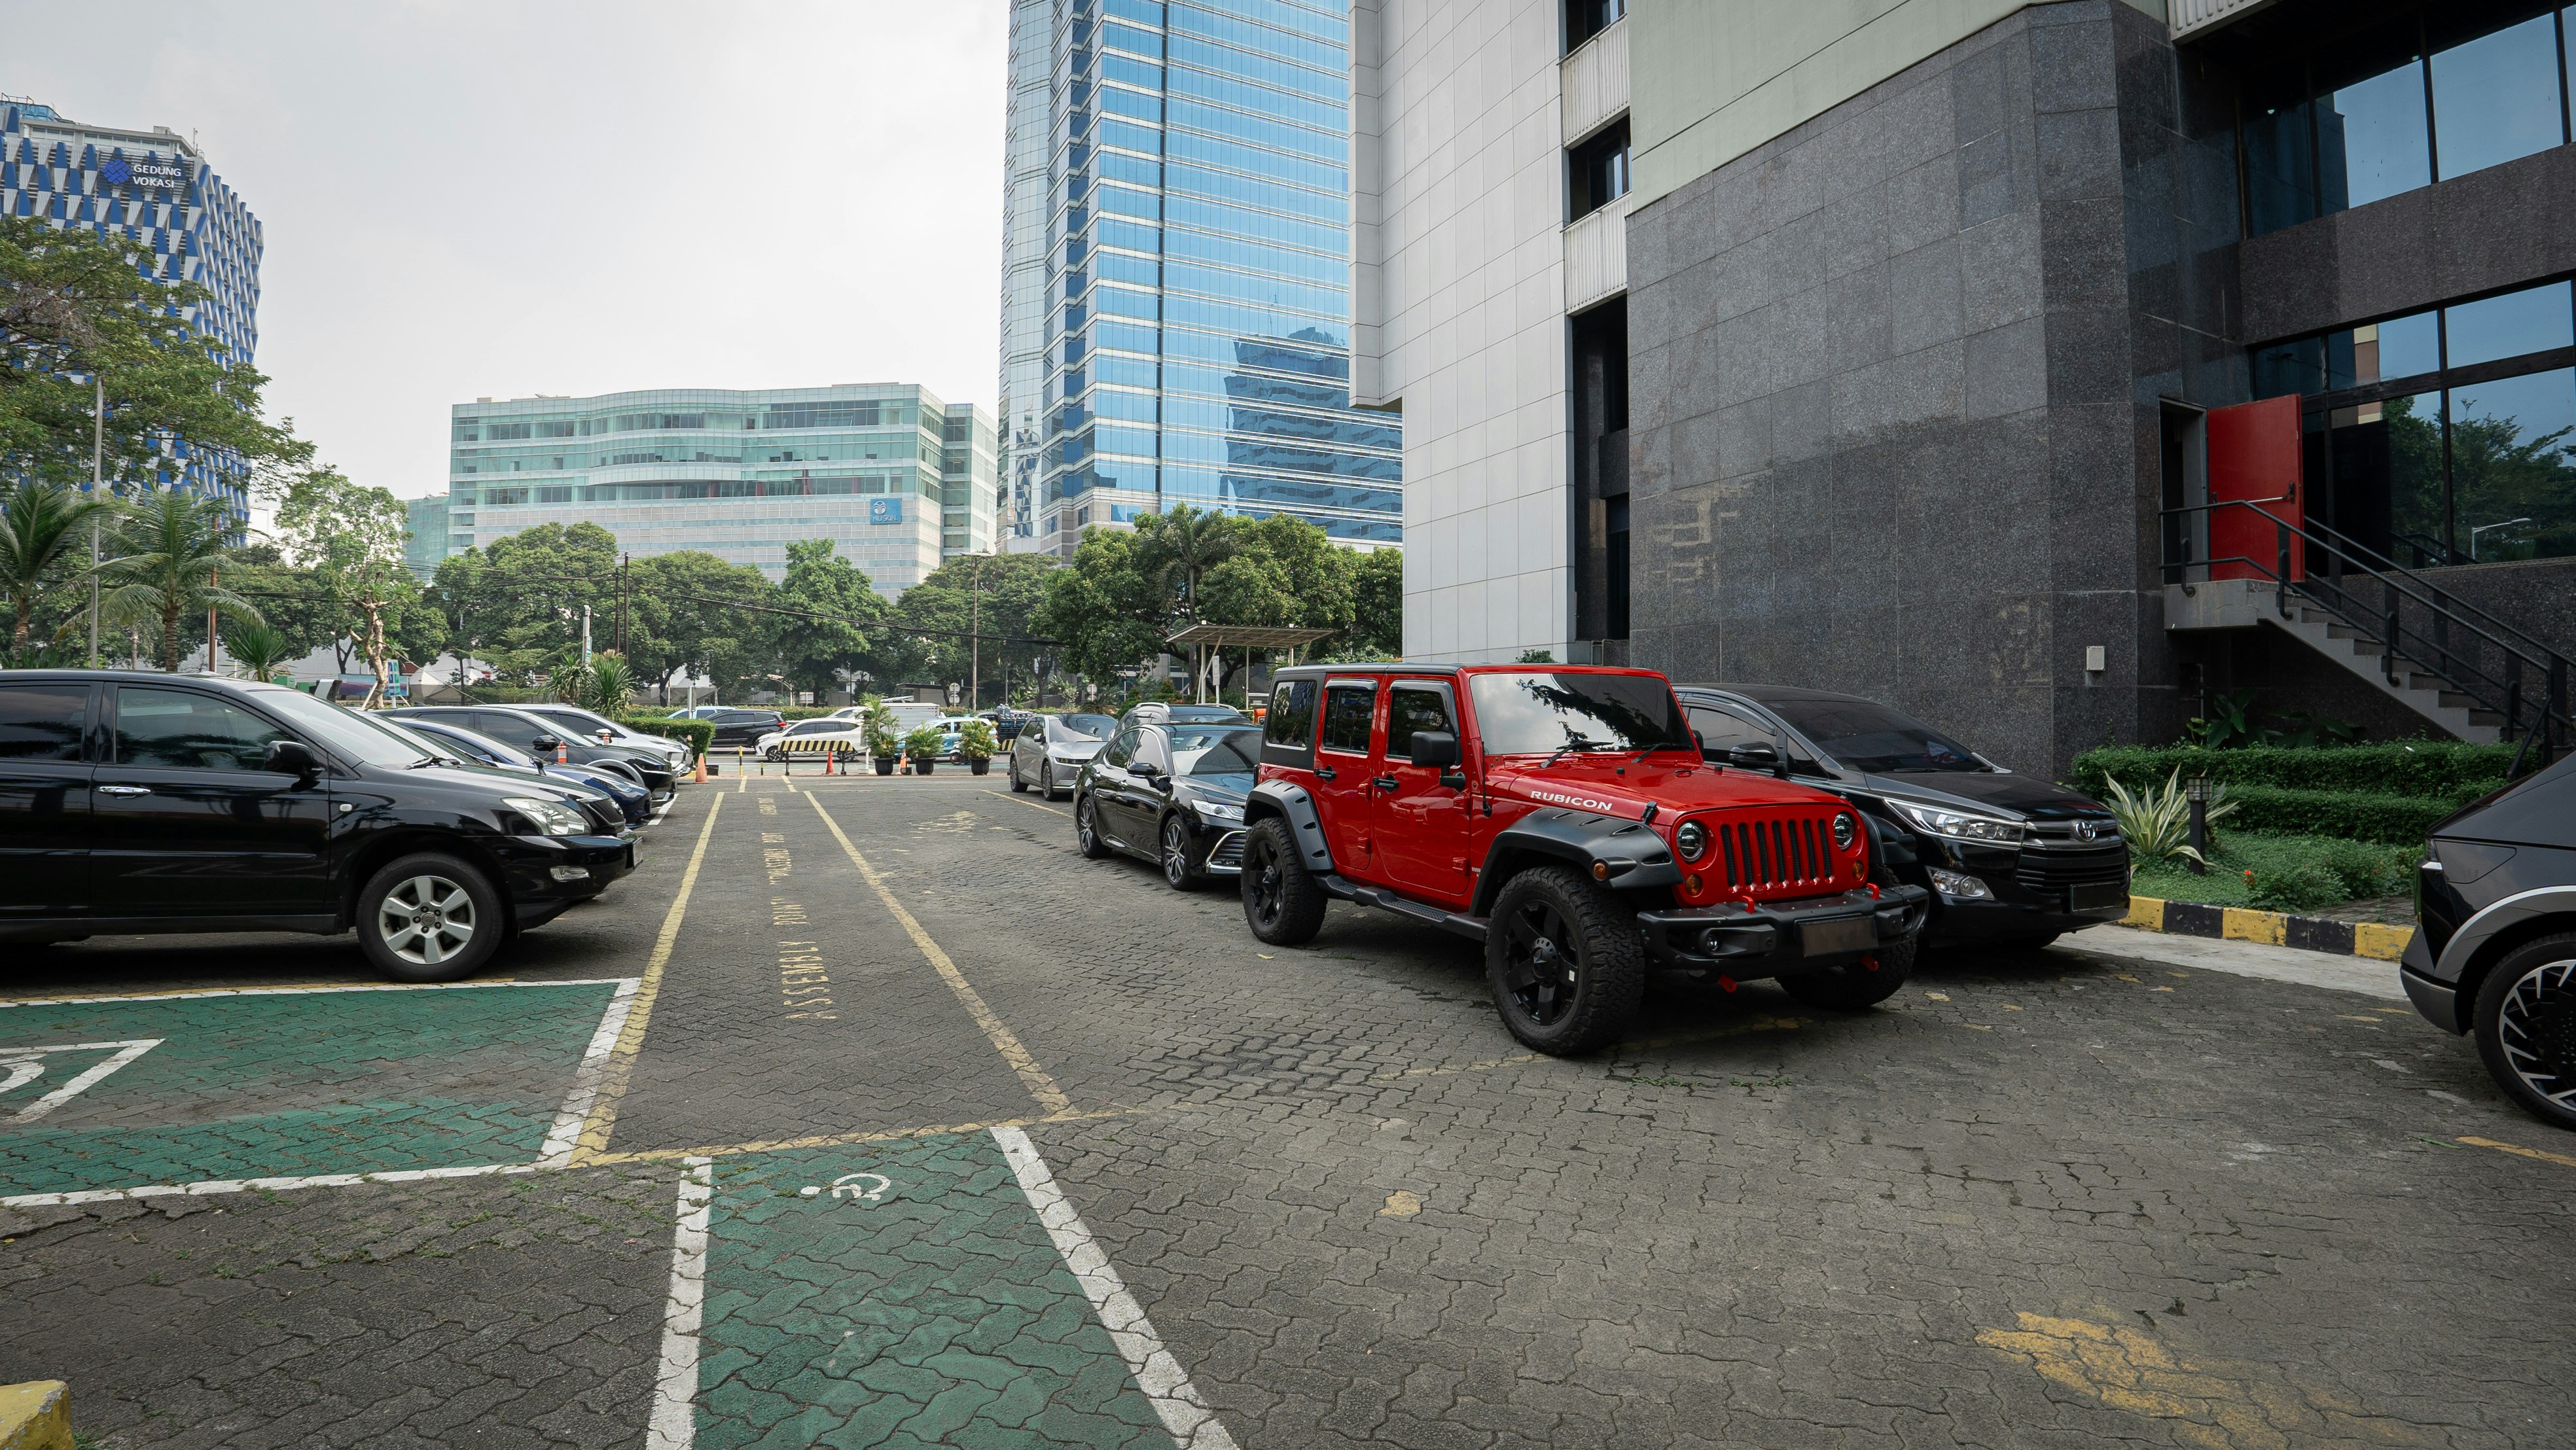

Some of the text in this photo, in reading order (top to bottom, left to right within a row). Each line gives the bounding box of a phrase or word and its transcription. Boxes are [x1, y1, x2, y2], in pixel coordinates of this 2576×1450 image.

[134, 164, 181, 177] GEDUNG
[132, 176, 175, 188] VOKASI
[1530, 790, 1613, 811] RUBICON
[777, 941, 837, 1019] ASSEMBLY
